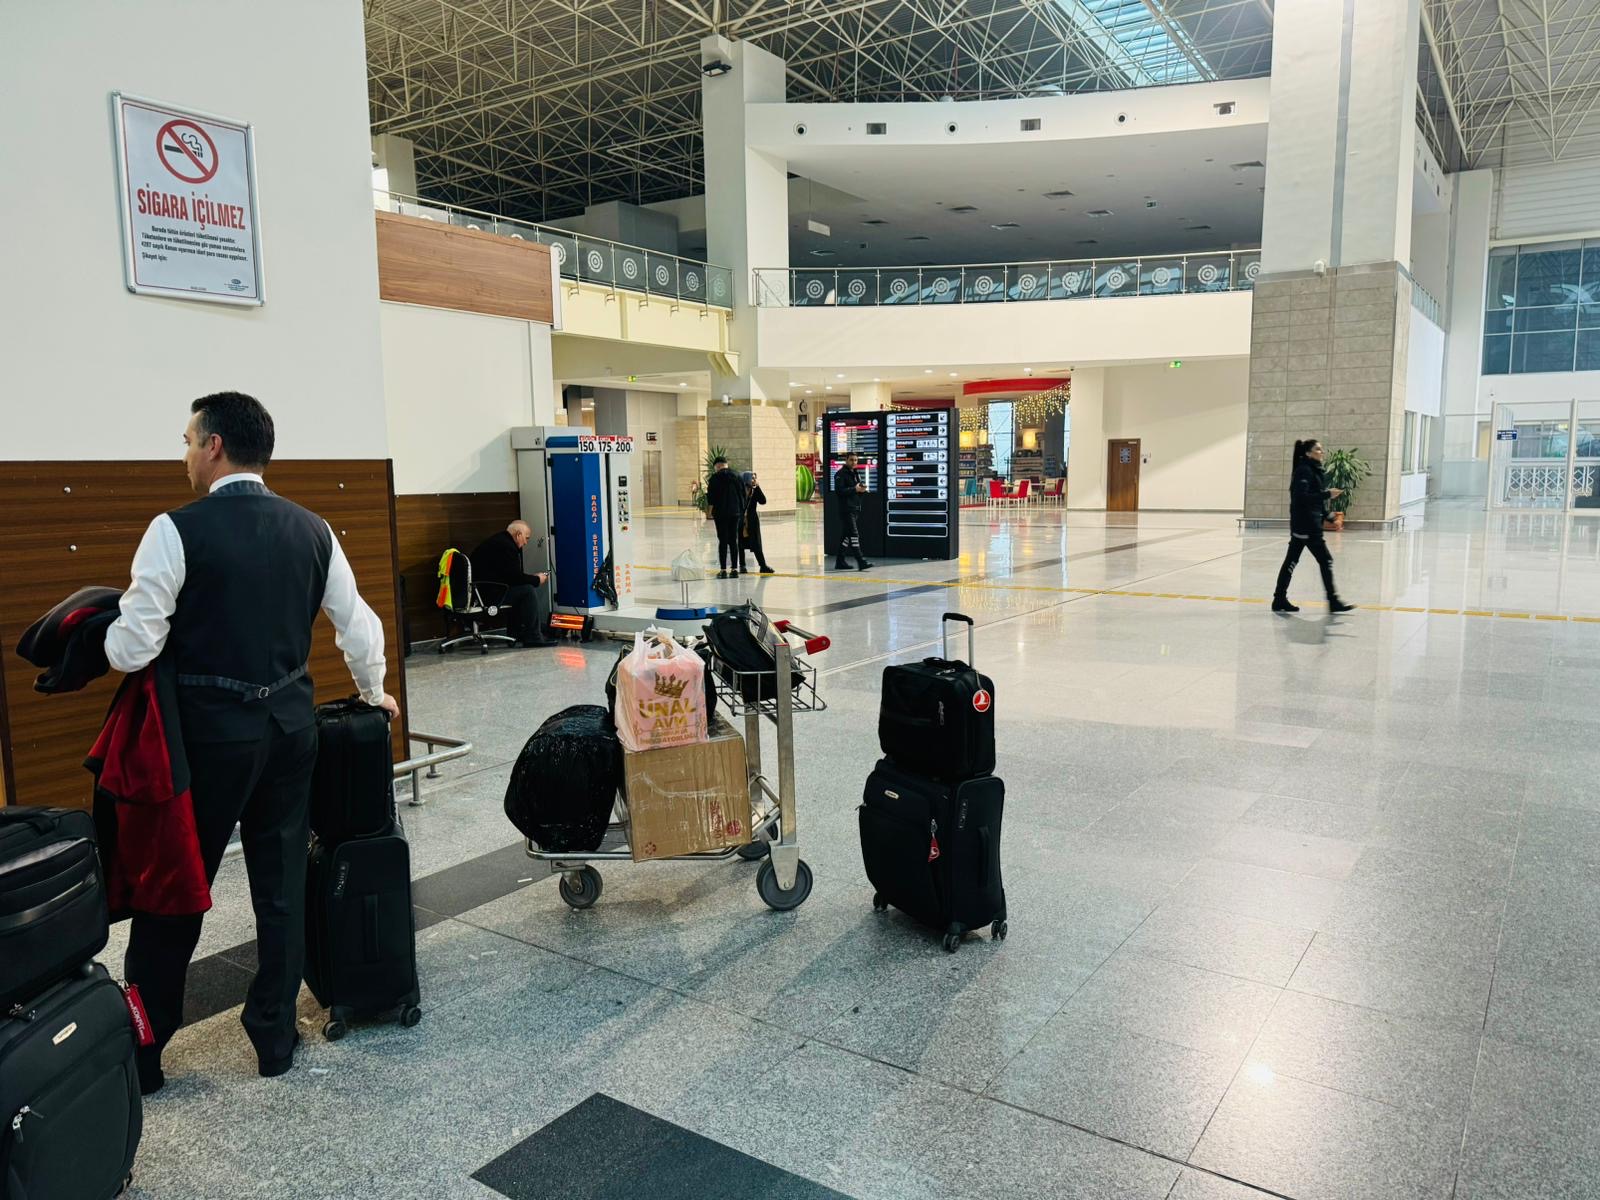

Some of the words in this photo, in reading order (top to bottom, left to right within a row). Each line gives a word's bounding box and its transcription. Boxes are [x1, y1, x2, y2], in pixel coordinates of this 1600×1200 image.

[137, 183, 189, 221] SİGARA
[191, 191, 246, 230] İÇİLMEZ
[652, 715, 688, 731] AVM
